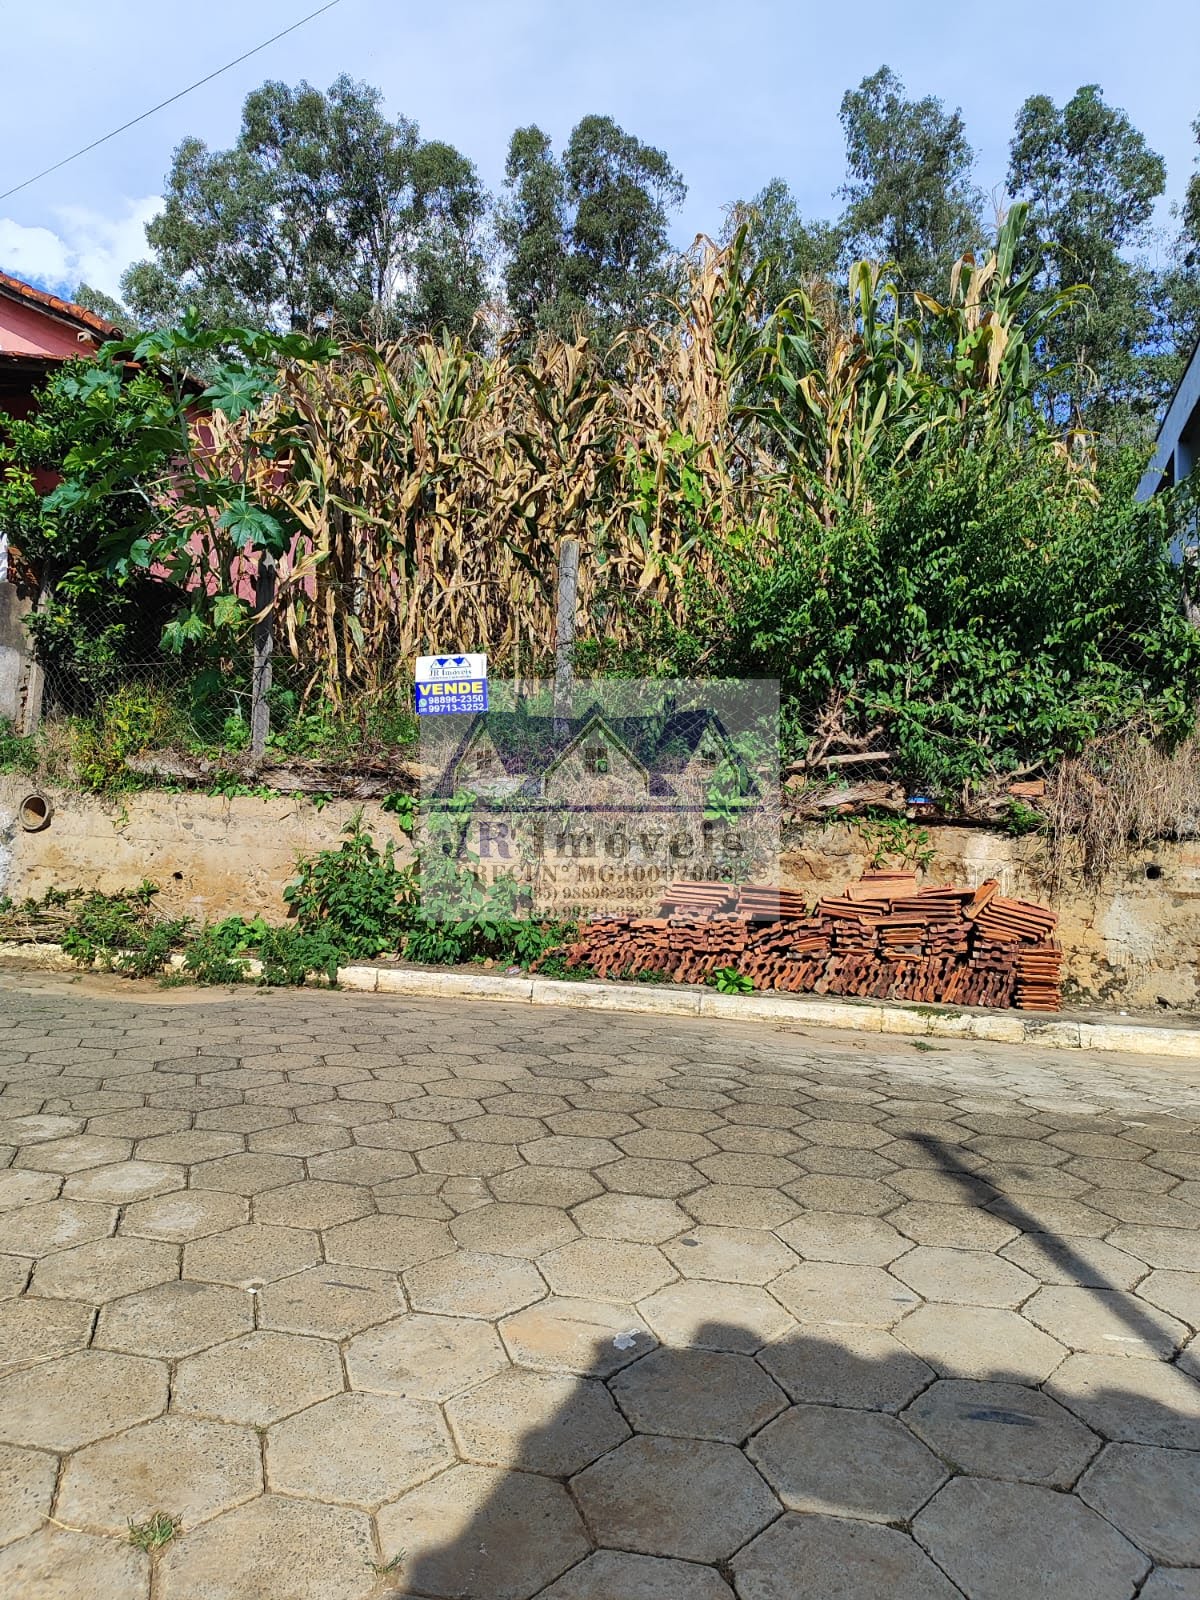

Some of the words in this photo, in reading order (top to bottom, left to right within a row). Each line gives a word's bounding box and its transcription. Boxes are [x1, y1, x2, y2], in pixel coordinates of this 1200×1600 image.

[419, 682, 483, 696] VENDE
[428, 695, 484, 705] 98896-2350
[428, 703, 484, 713] 99713-3252
